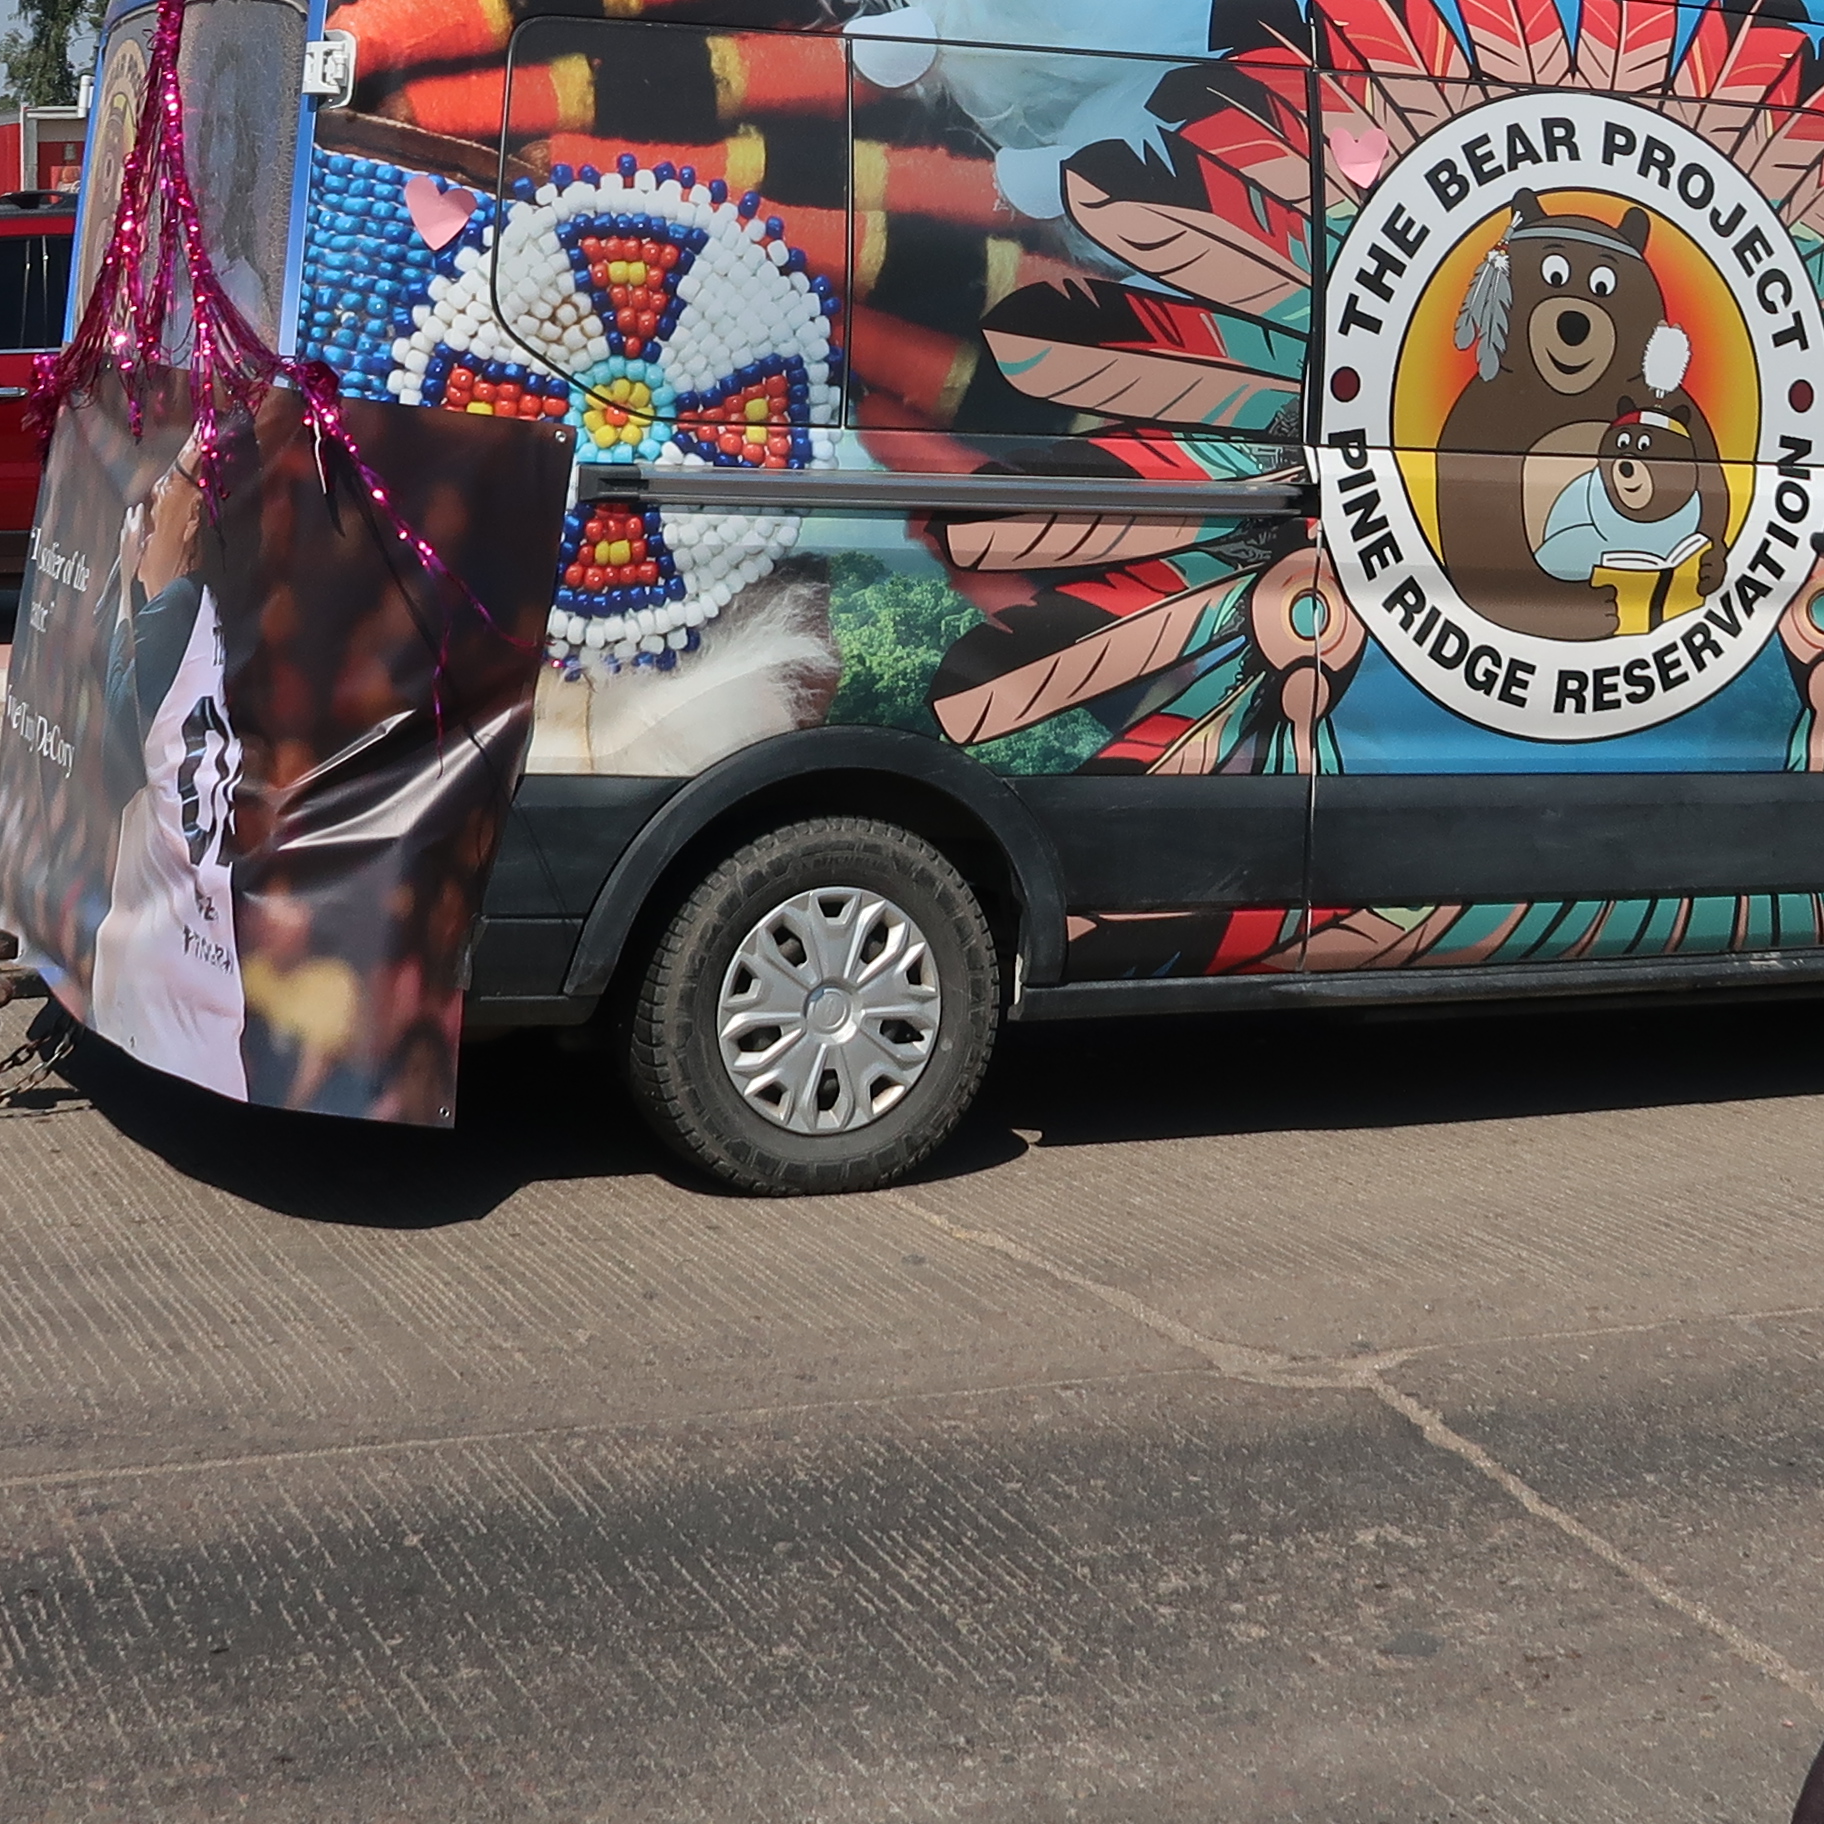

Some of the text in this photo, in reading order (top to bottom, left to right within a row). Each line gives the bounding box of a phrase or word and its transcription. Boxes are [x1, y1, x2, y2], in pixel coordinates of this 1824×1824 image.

[1338, 116, 1809, 353] THE BEAR PROJECT
[1328, 428, 1813, 714] PINE RIDGE RESERVATION
